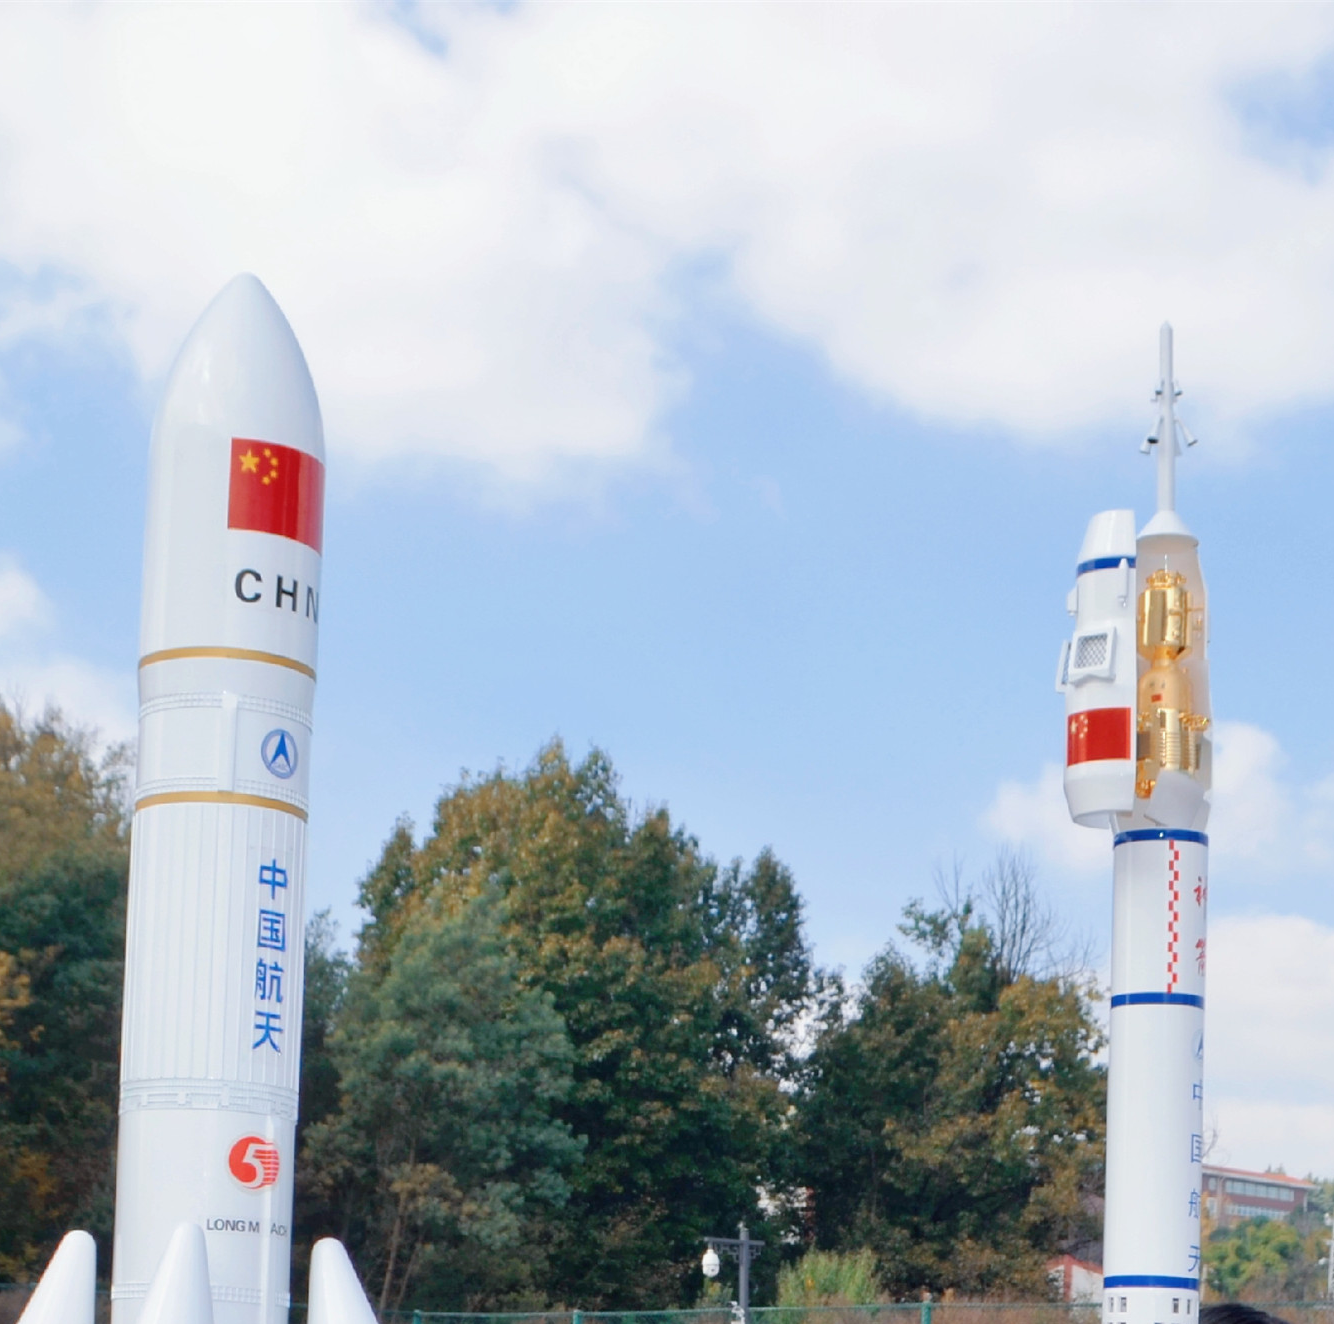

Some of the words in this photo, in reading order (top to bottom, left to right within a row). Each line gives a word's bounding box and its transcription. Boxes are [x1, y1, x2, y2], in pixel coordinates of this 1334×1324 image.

[251, 858, 289, 1055] 中国航天
[206, 1218, 246, 1232] LONG
